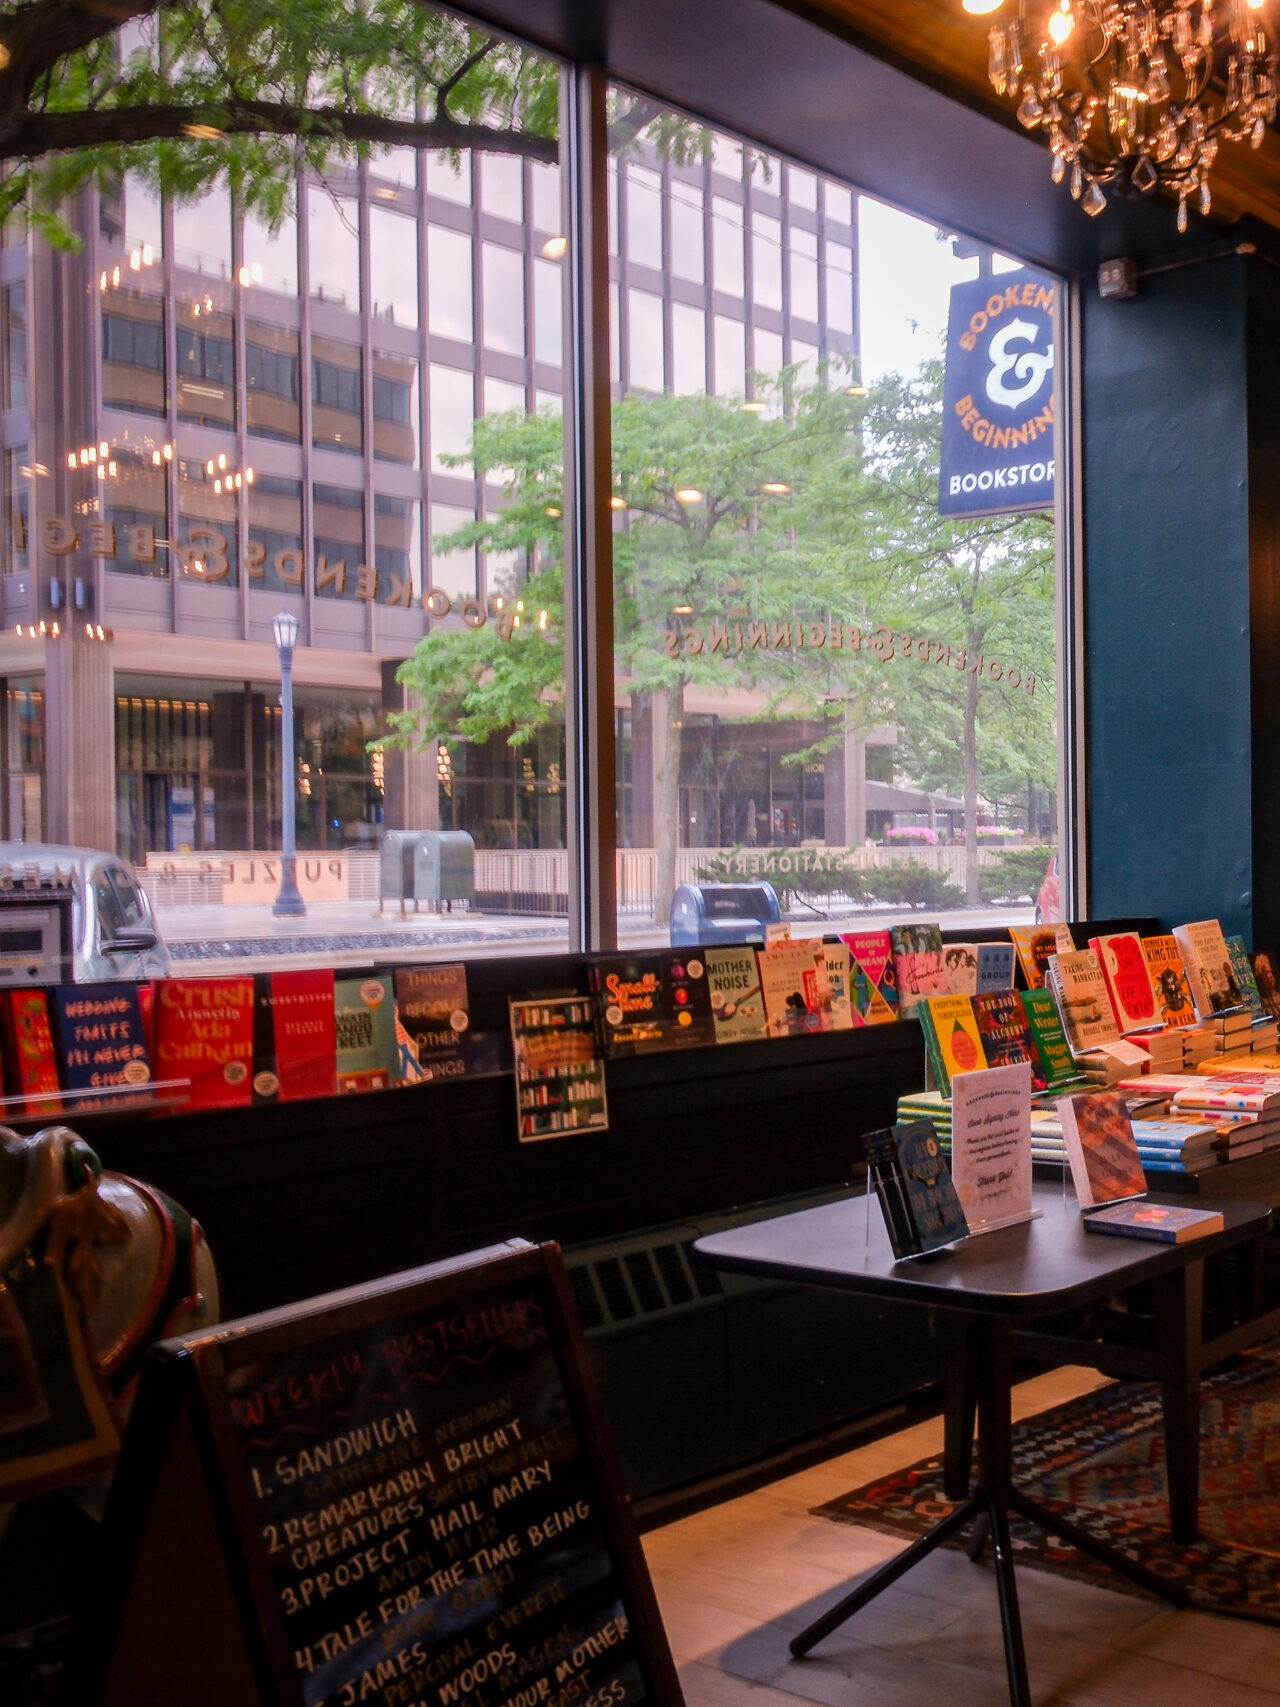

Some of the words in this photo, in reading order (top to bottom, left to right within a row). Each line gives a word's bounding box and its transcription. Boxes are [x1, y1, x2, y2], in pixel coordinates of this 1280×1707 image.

[958, 283, 1055, 351] BOOKEN
[985, 317, 1055, 411] &
[954, 393, 1055, 449] BEGINNIN
[950, 460, 1055, 495] BOOKSTOR
[855, 938, 886, 949] PEOPLE
[858, 955, 888, 967] MEANS
[1146, 948, 1167, 962] KING
[1167, 946, 1179, 960] TUT
[707, 960, 753, 976] MOTHER
[981, 971, 1011, 980] GROUP
[1064, 962, 1084, 976] TAKING
[408, 970, 458, 987] THINGS
[714, 975, 750, 991] NOISE
[161, 981, 254, 1009] Crush
[933, 998, 965, 1010] EVERYTHING
[980, 1000, 997, 1012] THE
[998, 996, 1018, 1008] BOOK
[65, 997, 132, 1018] WEDDING
[1033, 1001, 1051, 1014] Dear
[999, 1012, 1009, 1024] OF
[1034, 1017, 1060, 1030] Writer
[1163, 1017, 1178, 1029] SAM
[75, 1021, 132, 1042] TOASTS
[414, 1031, 461, 1049] OTHER
[991, 1024, 1025, 1040] ALCHEMY
[94, 1044, 145, 1064] NEVER
[1051, 1057, 1071, 1068] Smith
[233, 1351, 367, 1430] WEEKLY
[383, 1293, 545, 1376] BESTSELLERS
[275, 1408, 419, 1486] SANDWICH
[283, 1460, 437, 1545] REMARKABLY
[443, 1416, 523, 1473] BRIGHT
[291, 1495, 426, 1571] CREATURES
[299, 1528, 412, 1607] PROJECT
[428, 1499, 485, 1542] HAIL
[491, 1459, 553, 1509] MARY
[313, 1614, 373, 1661] TALE
[378, 1589, 425, 1625] FOR
[425, 1563, 467, 1596] THE
[468, 1534, 523, 1575] TIME
[527, 1499, 591, 1549] BEING
[377, 1550, 435, 1593] ANDY
[554, 1615, 631, 1683] MOTHER
[338, 1640, 429, 1706] JAMES
[383, 1637, 479, 1707] PERCIVAL
[438, 1641, 518, 1706] WOODS
